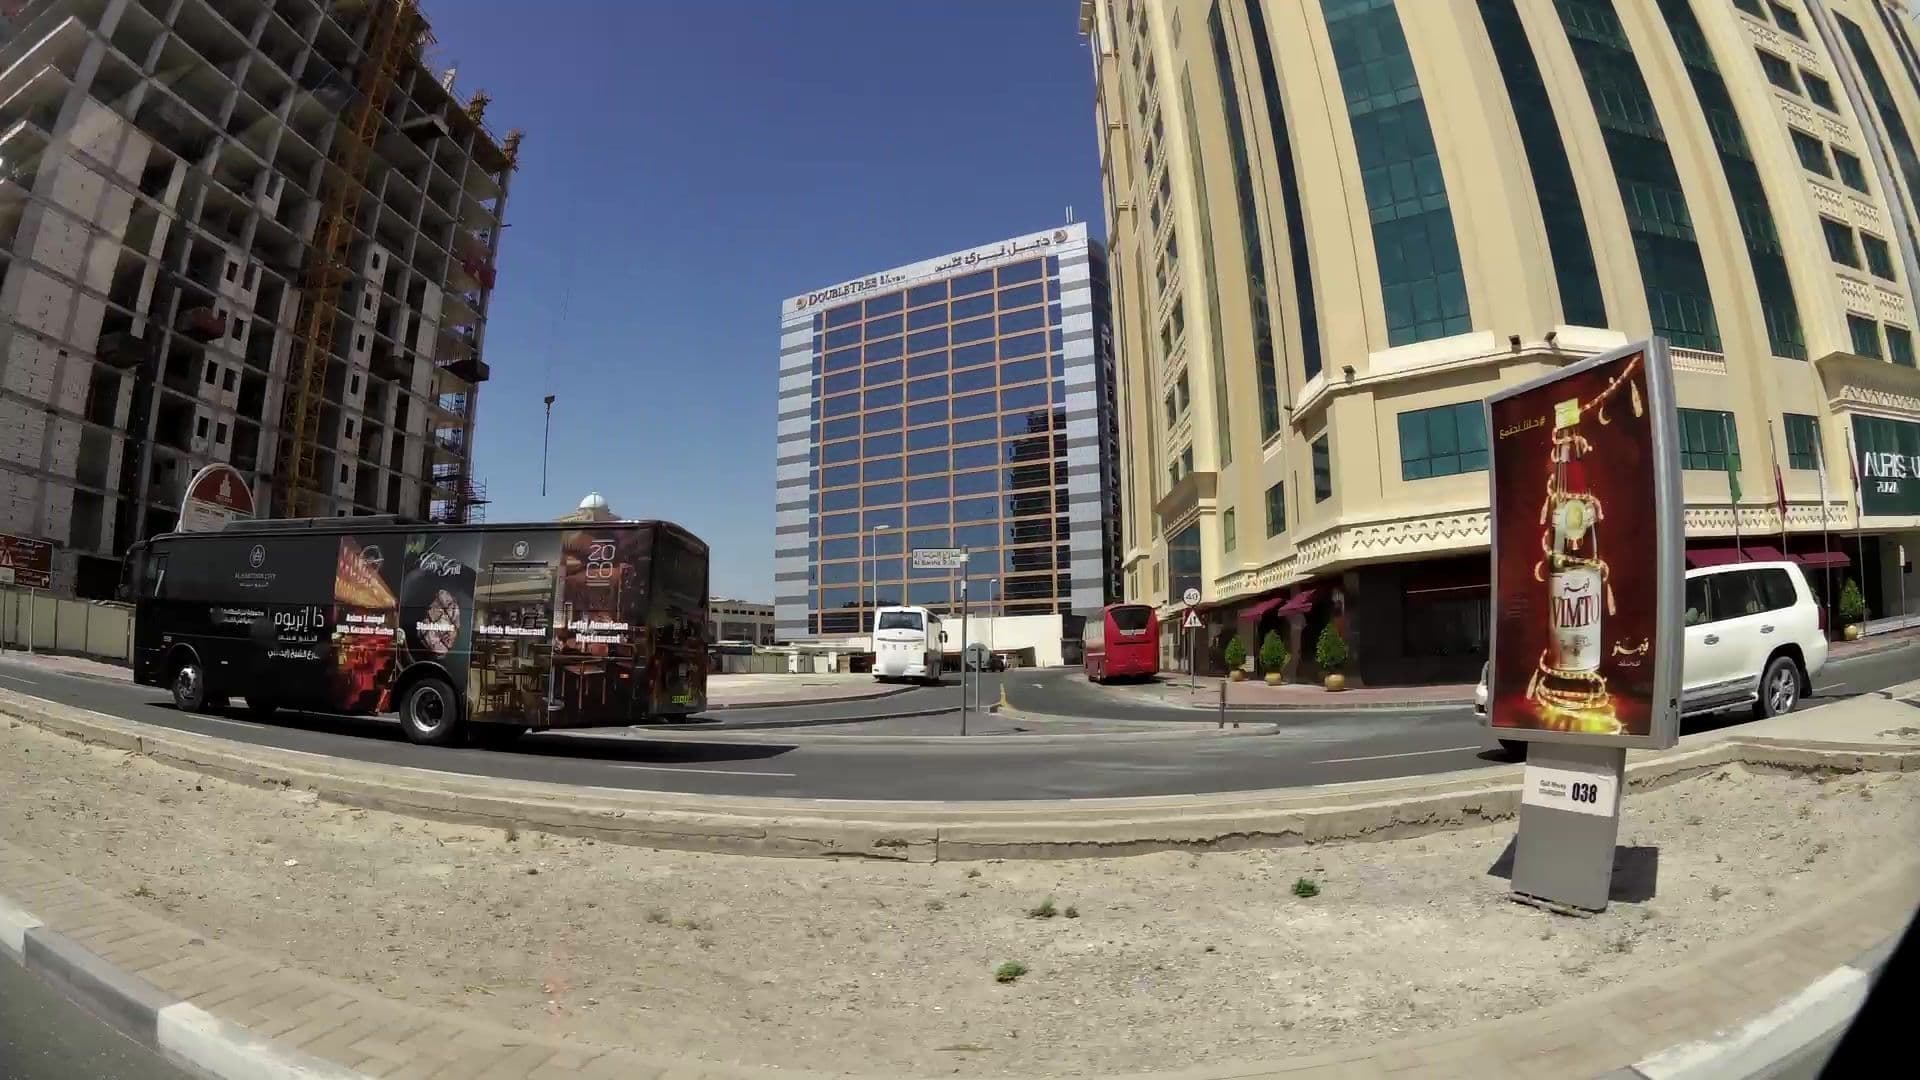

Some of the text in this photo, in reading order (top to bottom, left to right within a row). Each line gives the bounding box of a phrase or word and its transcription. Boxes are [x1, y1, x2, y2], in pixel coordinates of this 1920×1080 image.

[1551, 594, 1600, 630] VIMTO
[504, 625, 547, 637] Restaurant
[588, 620, 629, 631] American
[575, 632, 621, 643] Restaurant
[1571, 782, 1598, 804] 038
